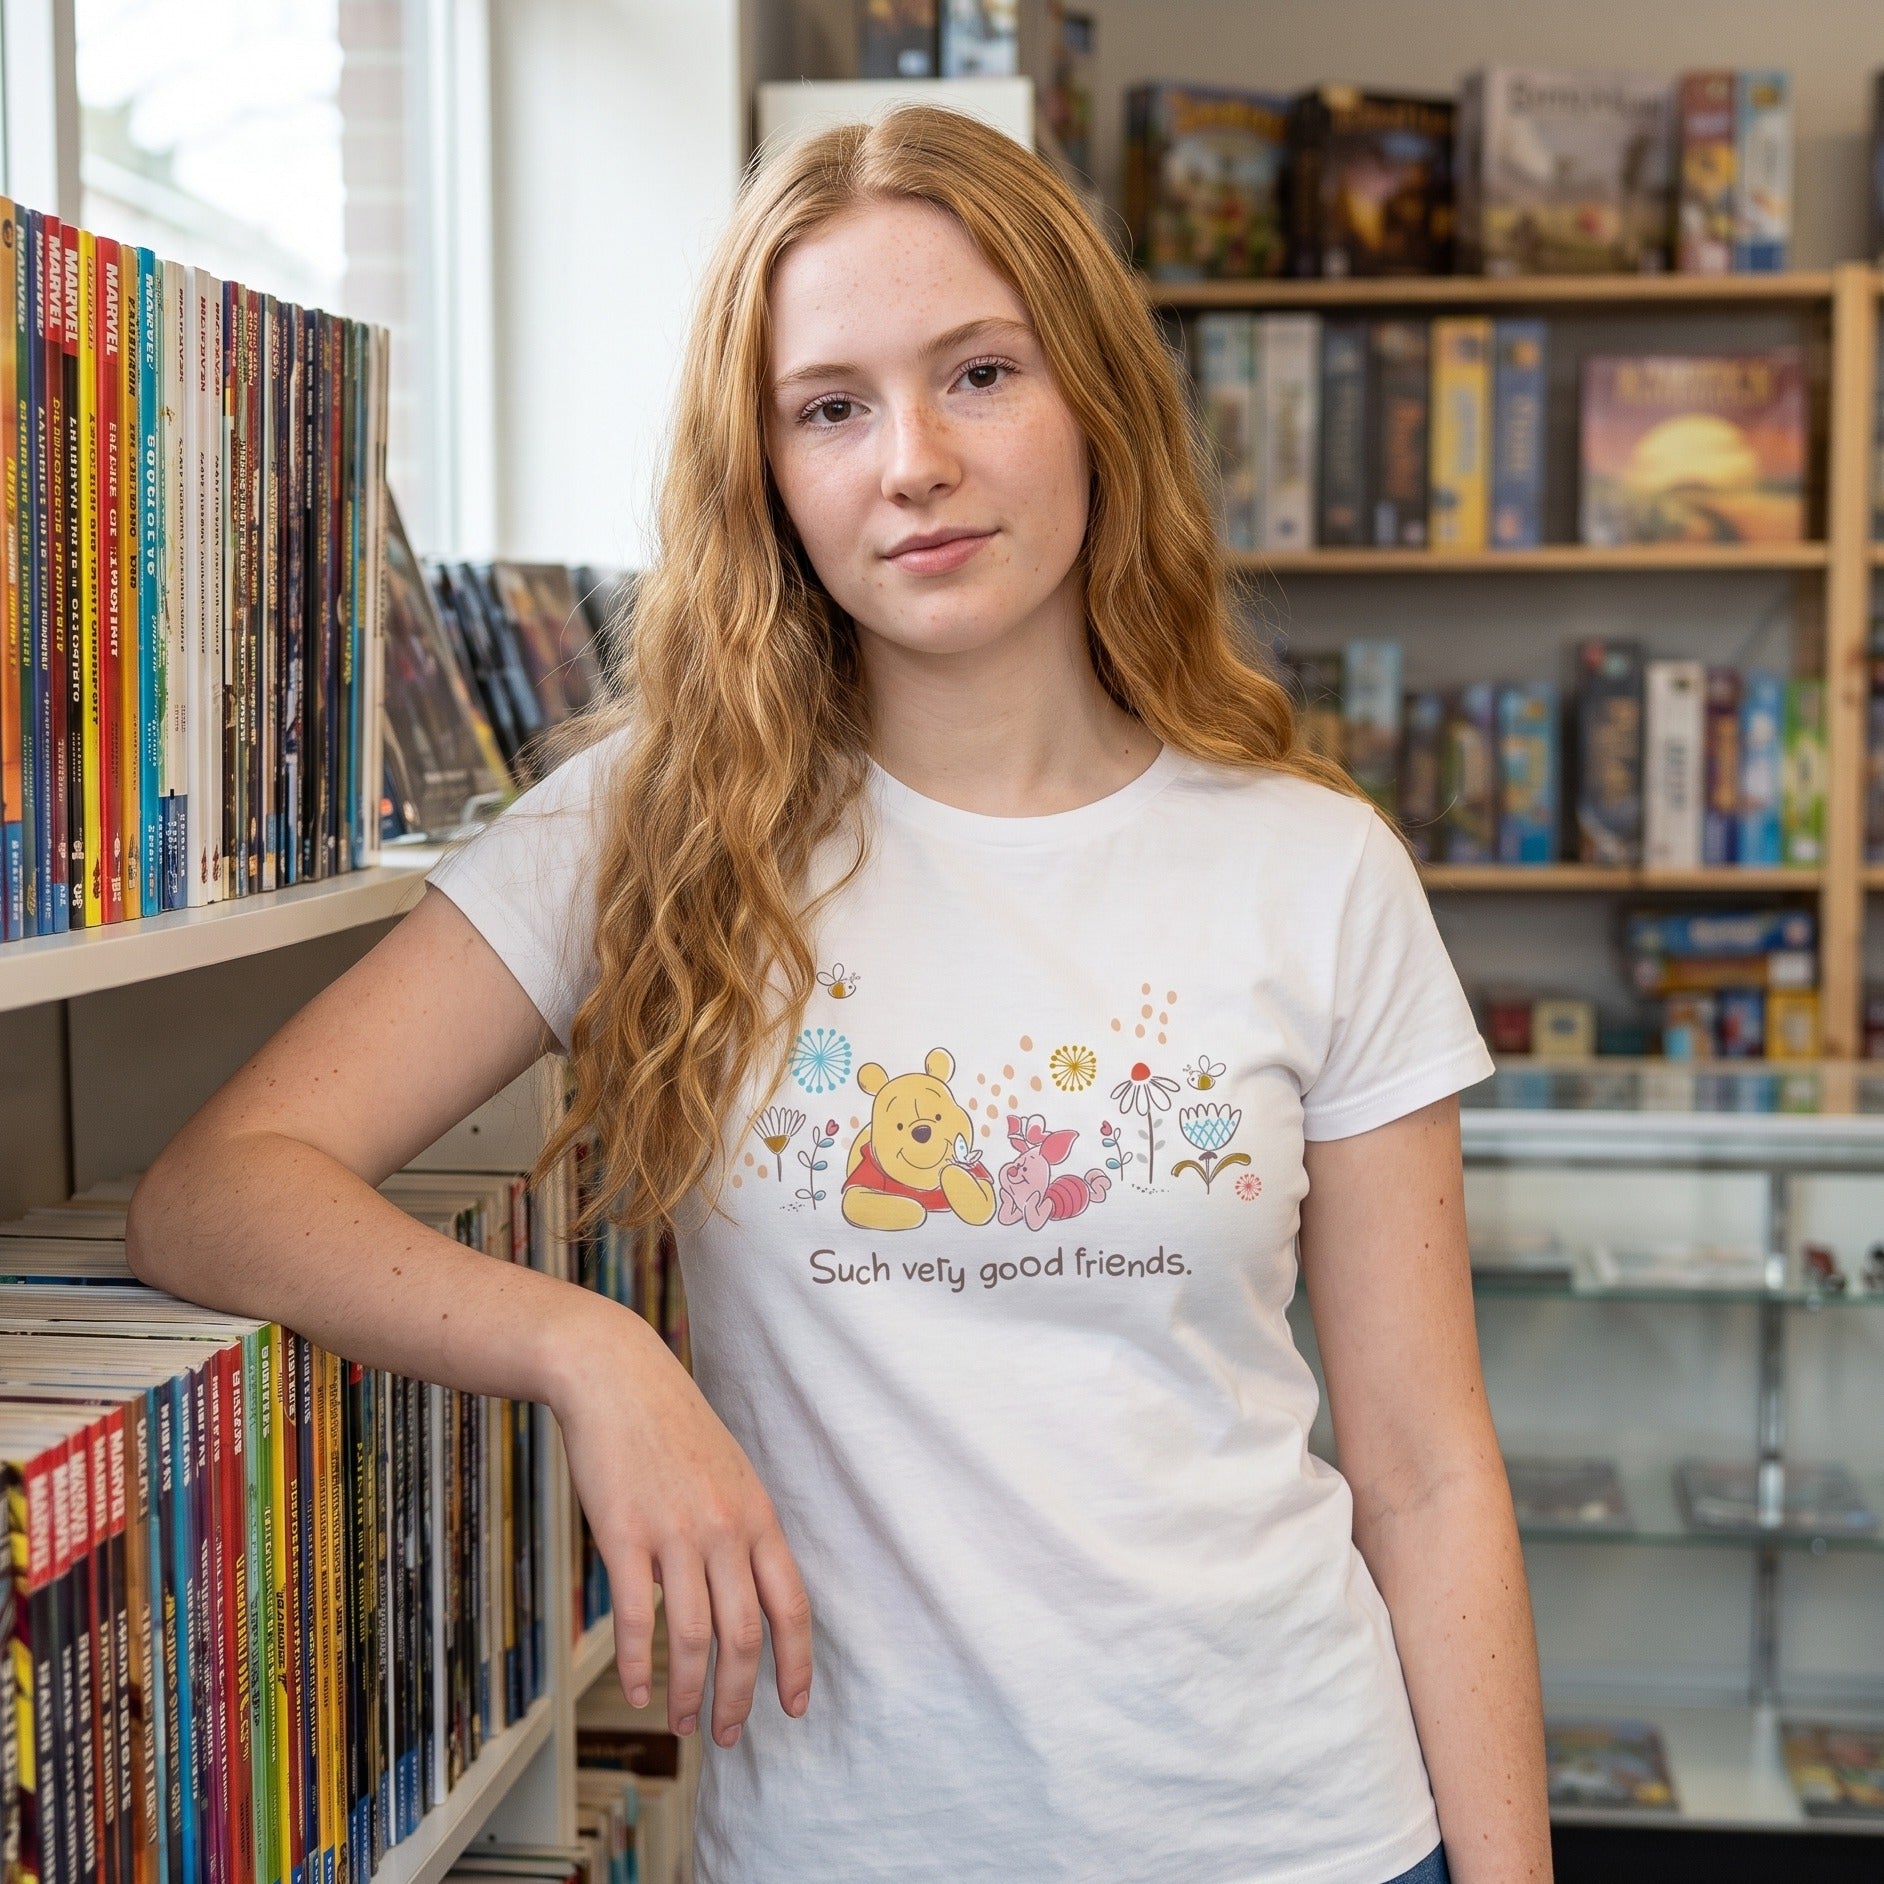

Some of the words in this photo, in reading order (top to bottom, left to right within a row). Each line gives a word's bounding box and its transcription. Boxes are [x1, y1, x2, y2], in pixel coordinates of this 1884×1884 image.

[48, 234, 61, 329] MARVEL
[64, 248, 78, 343] MARVEL
[106, 262, 119, 356] MARVEL
[809, 1248, 890, 1285] Such
[902, 1256, 966, 1293] very
[979, 1246, 1064, 1289] good
[1075, 1245, 1193, 1279] friends.
